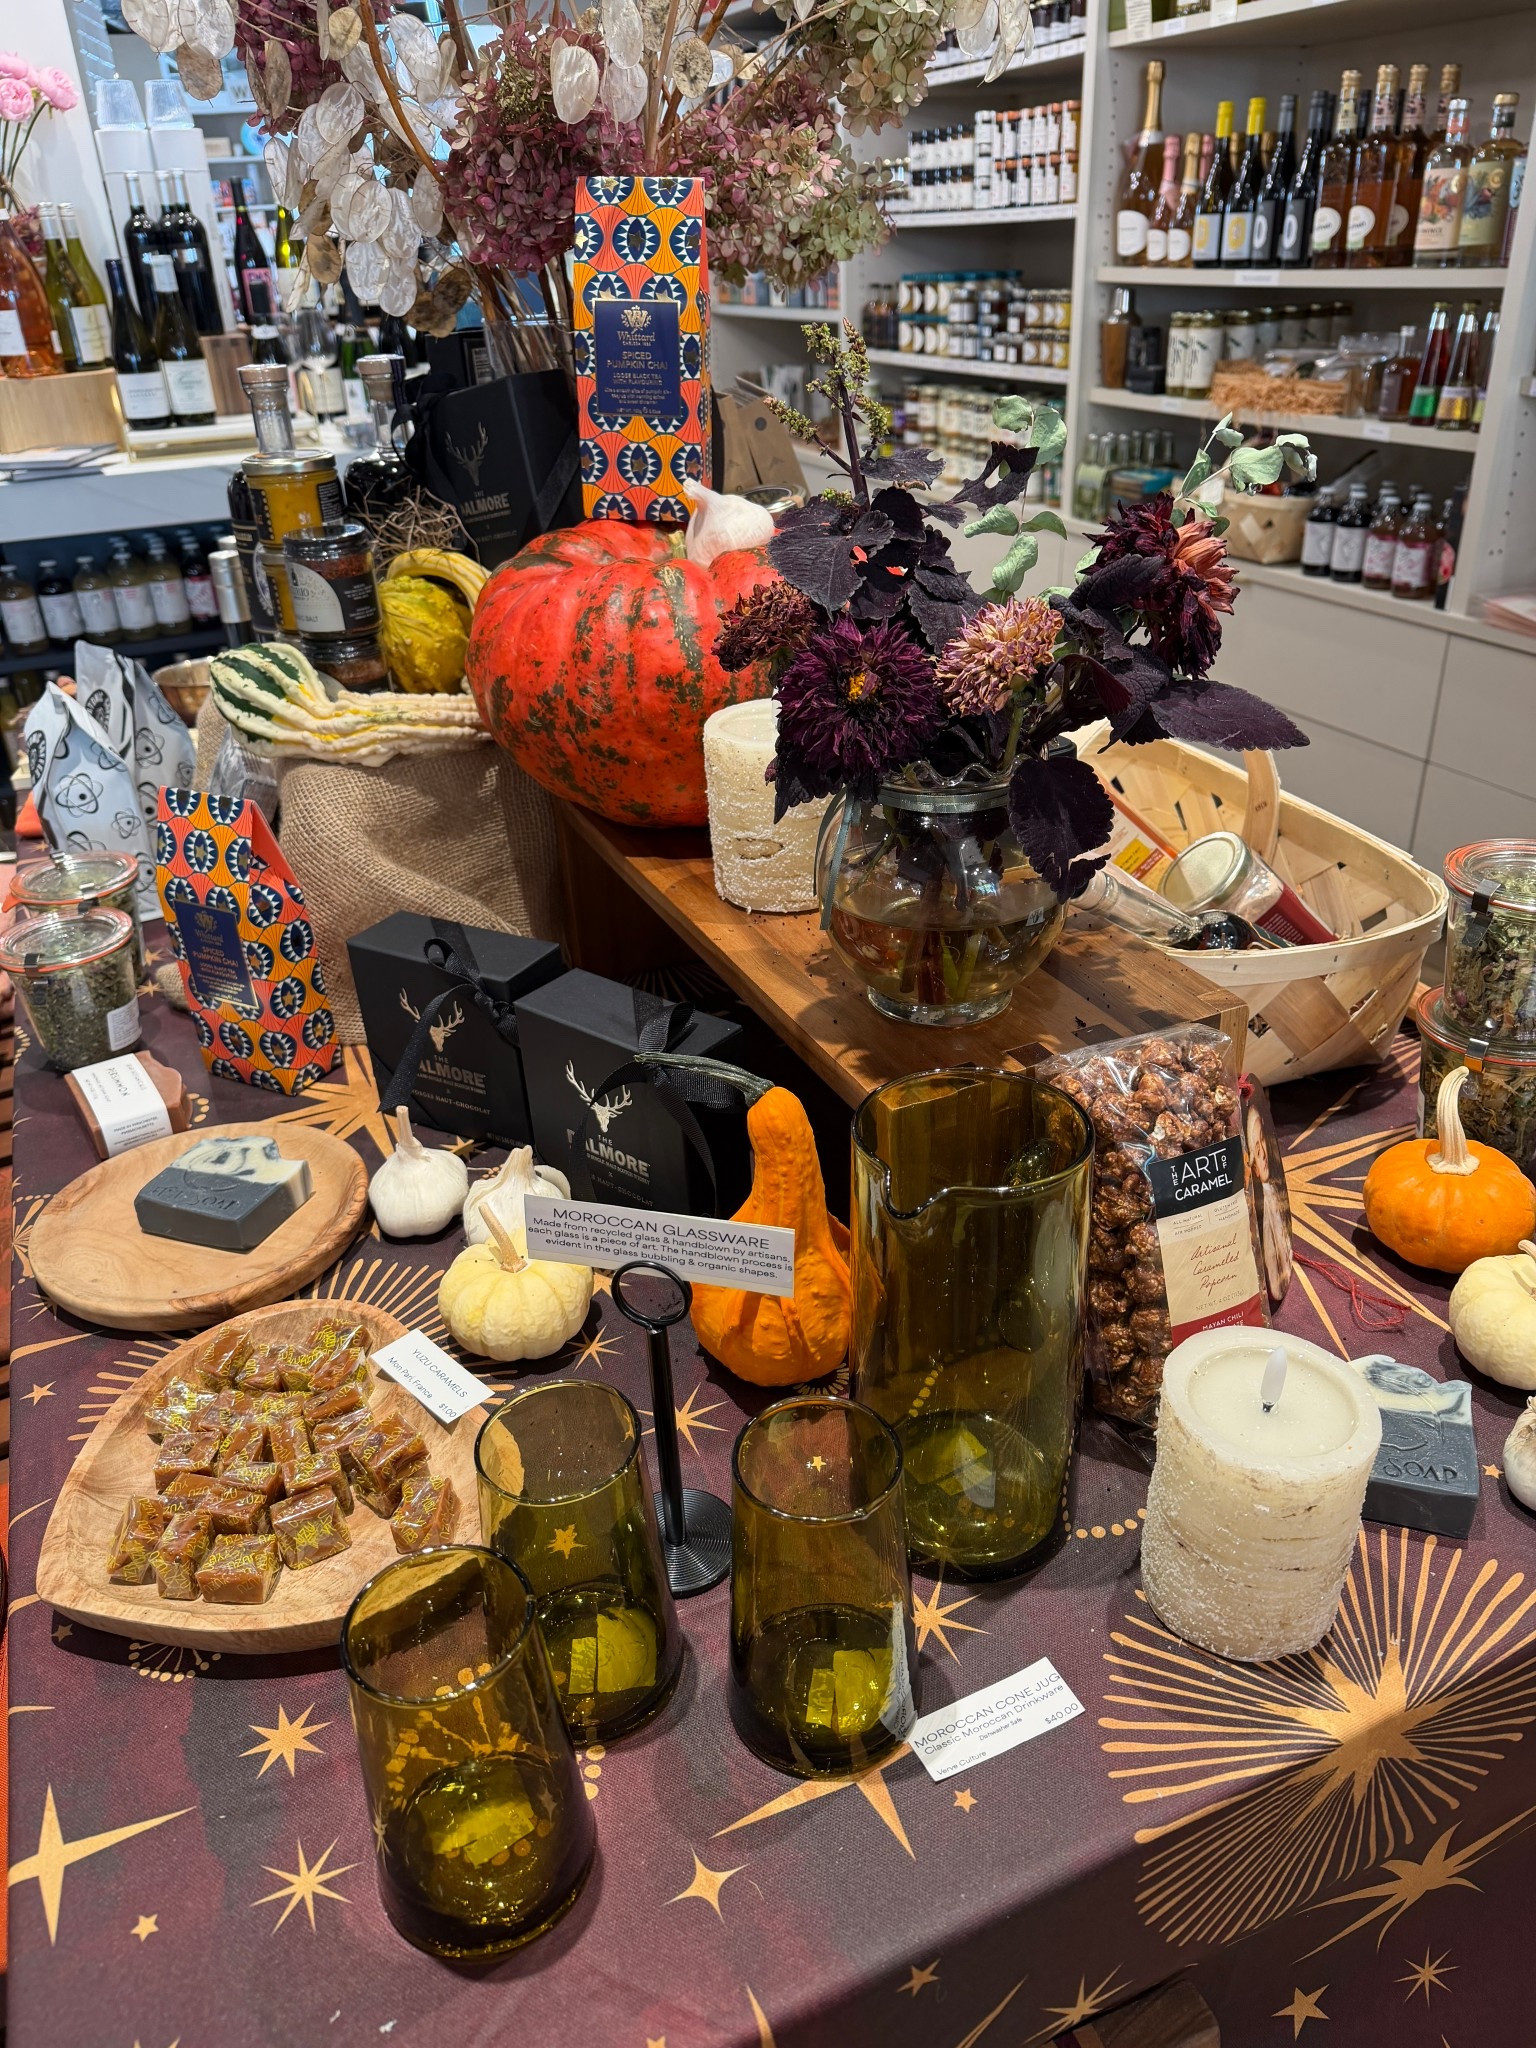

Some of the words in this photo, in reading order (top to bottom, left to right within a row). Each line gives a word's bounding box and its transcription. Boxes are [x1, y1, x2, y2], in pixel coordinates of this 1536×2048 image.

[617, 331, 656, 342] Whittard
[606, 360, 645, 369] PUMPKIN
[647, 361, 668, 370] CHAI
[622, 351, 652, 360] SPICED
[632, 372, 650, 380] BLACK
[434, 1054, 448, 1063] THE
[419, 1060, 486, 1088] ALMORE
[435, 1096, 490, 1115] HAUT-CHOCOLAT
[598, 1134, 612, 1146] THE
[1170, 1165, 1178, 1186] THE
[1181, 1148, 1227, 1183] ART
[1221, 1155, 1227, 1169] OF
[1175, 1173, 1233, 1201] CARAMEL
[533, 1217, 561, 1228] Made
[564, 1222, 588, 1232] from
[591, 1226, 632, 1238] recycled
[635, 1232, 660, 1243] glass
[673, 1238, 730, 1253] handblown
[733, 1245, 745, 1256] by
[748, 1248, 790, 1262] artisans,
[553, 1208, 657, 1233] MOROCCAN
[663, 1224, 770, 1249] GLASSWARE
[528, 1226, 552, 1235] each
[555, 1229, 579, 1239] glass
[582, 1233, 590, 1241] is
[601, 1237, 626, 1246] piece
[629, 1240, 639, 1248] of
[642, 1243, 658, 1251] art.
[661, 1245, 679, 1254] The
[681, 1248, 740, 1263] handblown
[742, 1257, 782, 1270] process
[546, 1238, 581, 1249] evident
[584, 1242, 592, 1250] in
[595, 1244, 610, 1253] the
[613, 1246, 638, 1257] glass
[641, 1252, 685, 1266] bubbling
[698, 1261, 736, 1272] organic
[738, 1267, 778, 1278] shapes.
[1190, 1233, 1237, 1260] Artisanal
[1200, 1275, 1237, 1297] Popcorn
[1202, 1319, 1226, 1330] MAYAN
[1228, 1312, 1244, 1322] CHILI
[388, 1357, 402, 1371] Mon
[412, 1380, 433, 1399] France
[412, 1348, 431, 1367] YUZU
[429, 1364, 467, 1398] CARAMELS
[1382, 1457, 1458, 1483] SOAP
[914, 1705, 994, 1749] MOROCCAN
[996, 1687, 1033, 1710] CONE
[1035, 1672, 1061, 1693] JUG
[924, 1736, 961, 1755] Classic
[961, 1710, 1014, 1739] Moroccan
[1015, 1685, 1064, 1713] Drinkware
[1044, 1702, 1079, 1725] $40.00
[978, 1723, 1010, 1741] Dishwasher
[1011, 1717, 1023, 1726] Safe
[936, 1763, 958, 1776] Verve
[959, 1751, 987, 1767] Culture
